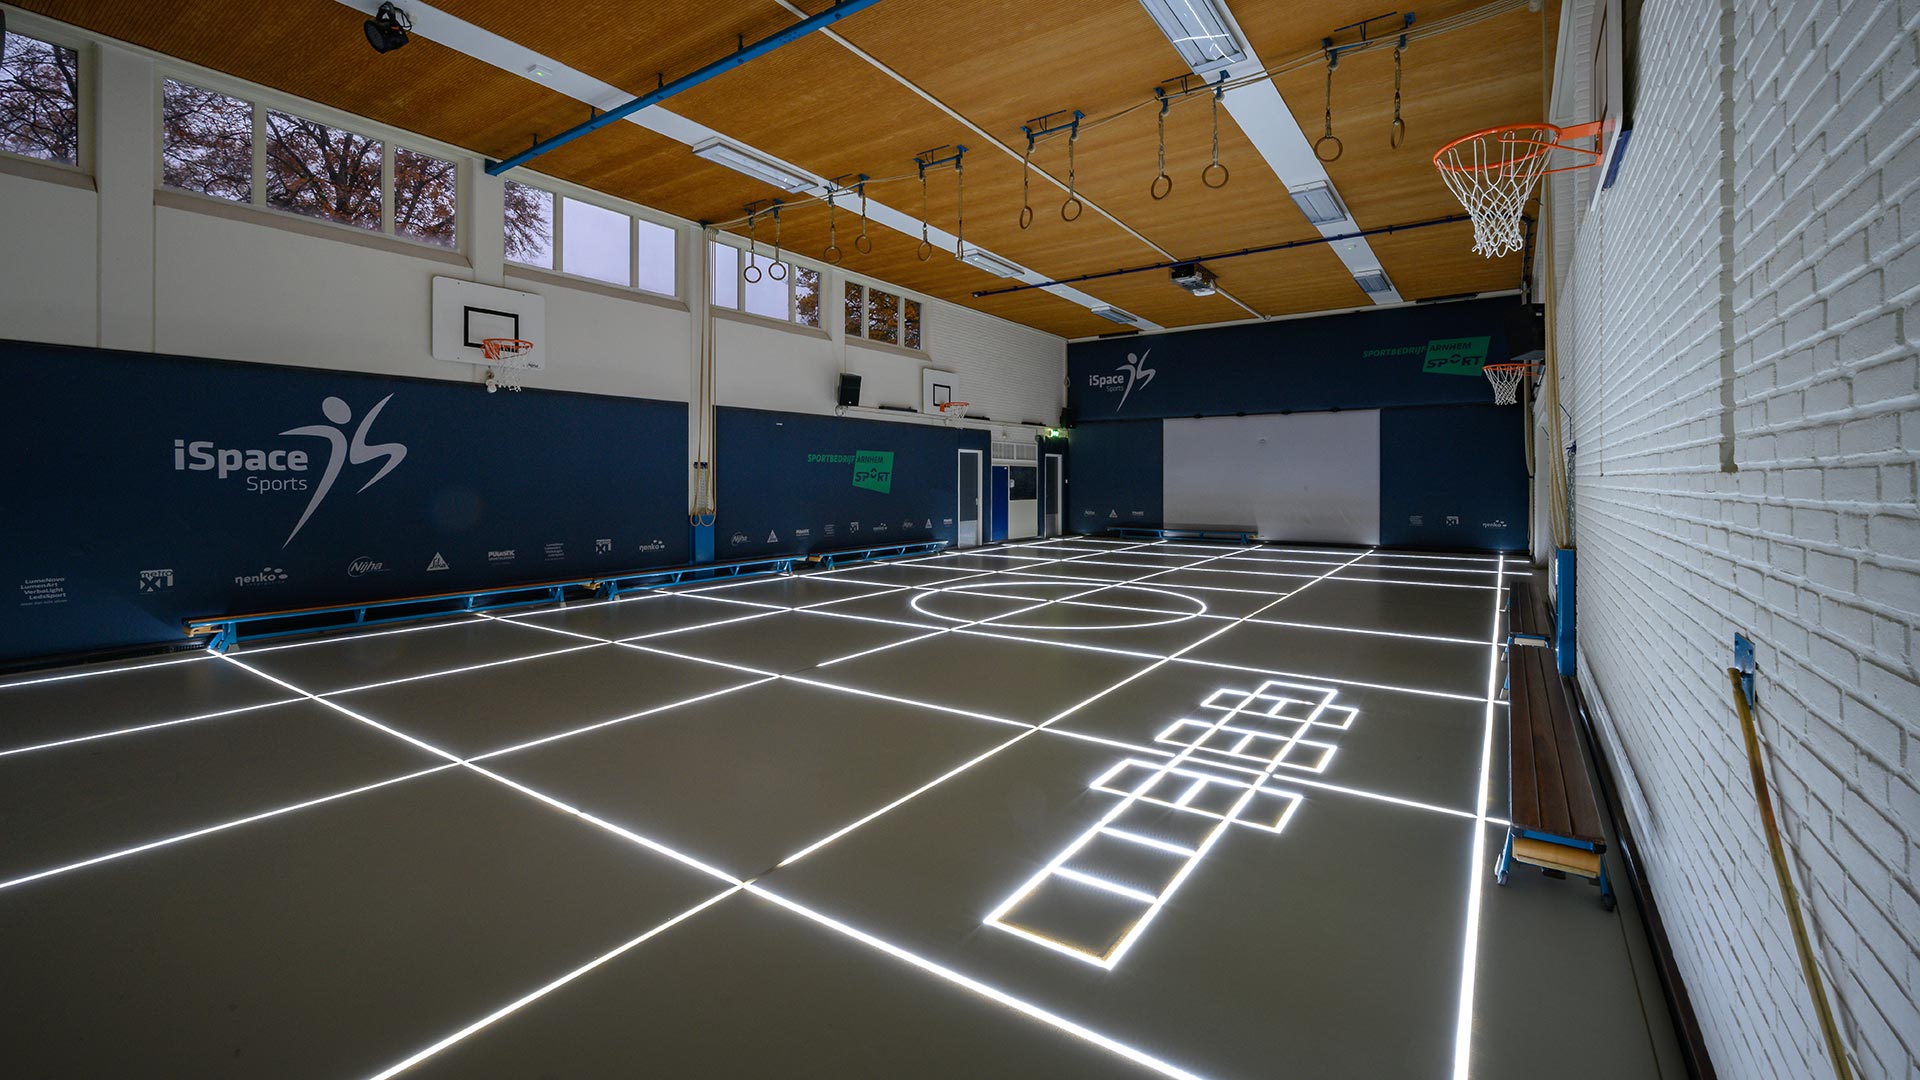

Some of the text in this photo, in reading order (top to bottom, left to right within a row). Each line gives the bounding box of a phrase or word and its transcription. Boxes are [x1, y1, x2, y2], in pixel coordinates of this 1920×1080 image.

[1362, 342, 1472, 358] SPORTBEDRIJF ARNHEM
[1426, 354, 1483, 368] SPORT
[1089, 375, 1124, 388] iSpace
[174, 439, 308, 478] iSpace
[807, 454, 884, 464] SPORTBEDRIJF ARNHEM
[855, 467, 890, 482] SPORT
[246, 476, 308, 494] Sports
[350, 561, 383, 573] Nijha
